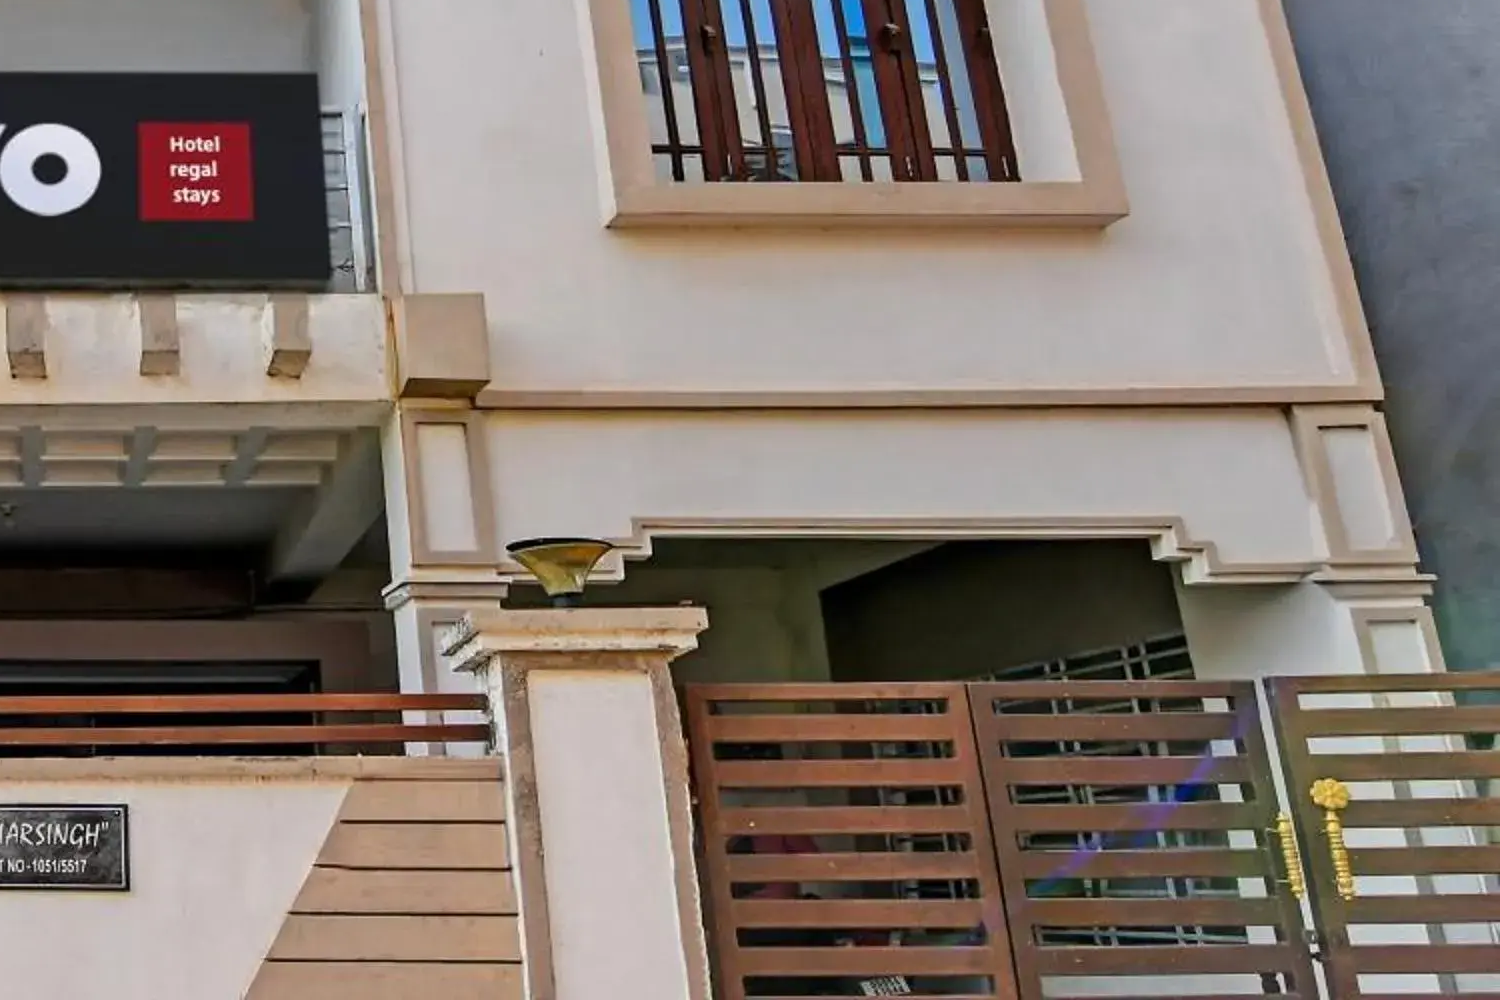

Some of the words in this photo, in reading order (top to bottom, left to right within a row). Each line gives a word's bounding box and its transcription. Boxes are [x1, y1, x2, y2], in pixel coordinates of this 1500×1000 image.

[169, 136, 221, 153] Hotel
[169, 160, 218, 181] regal
[172, 187, 221, 206] stays
